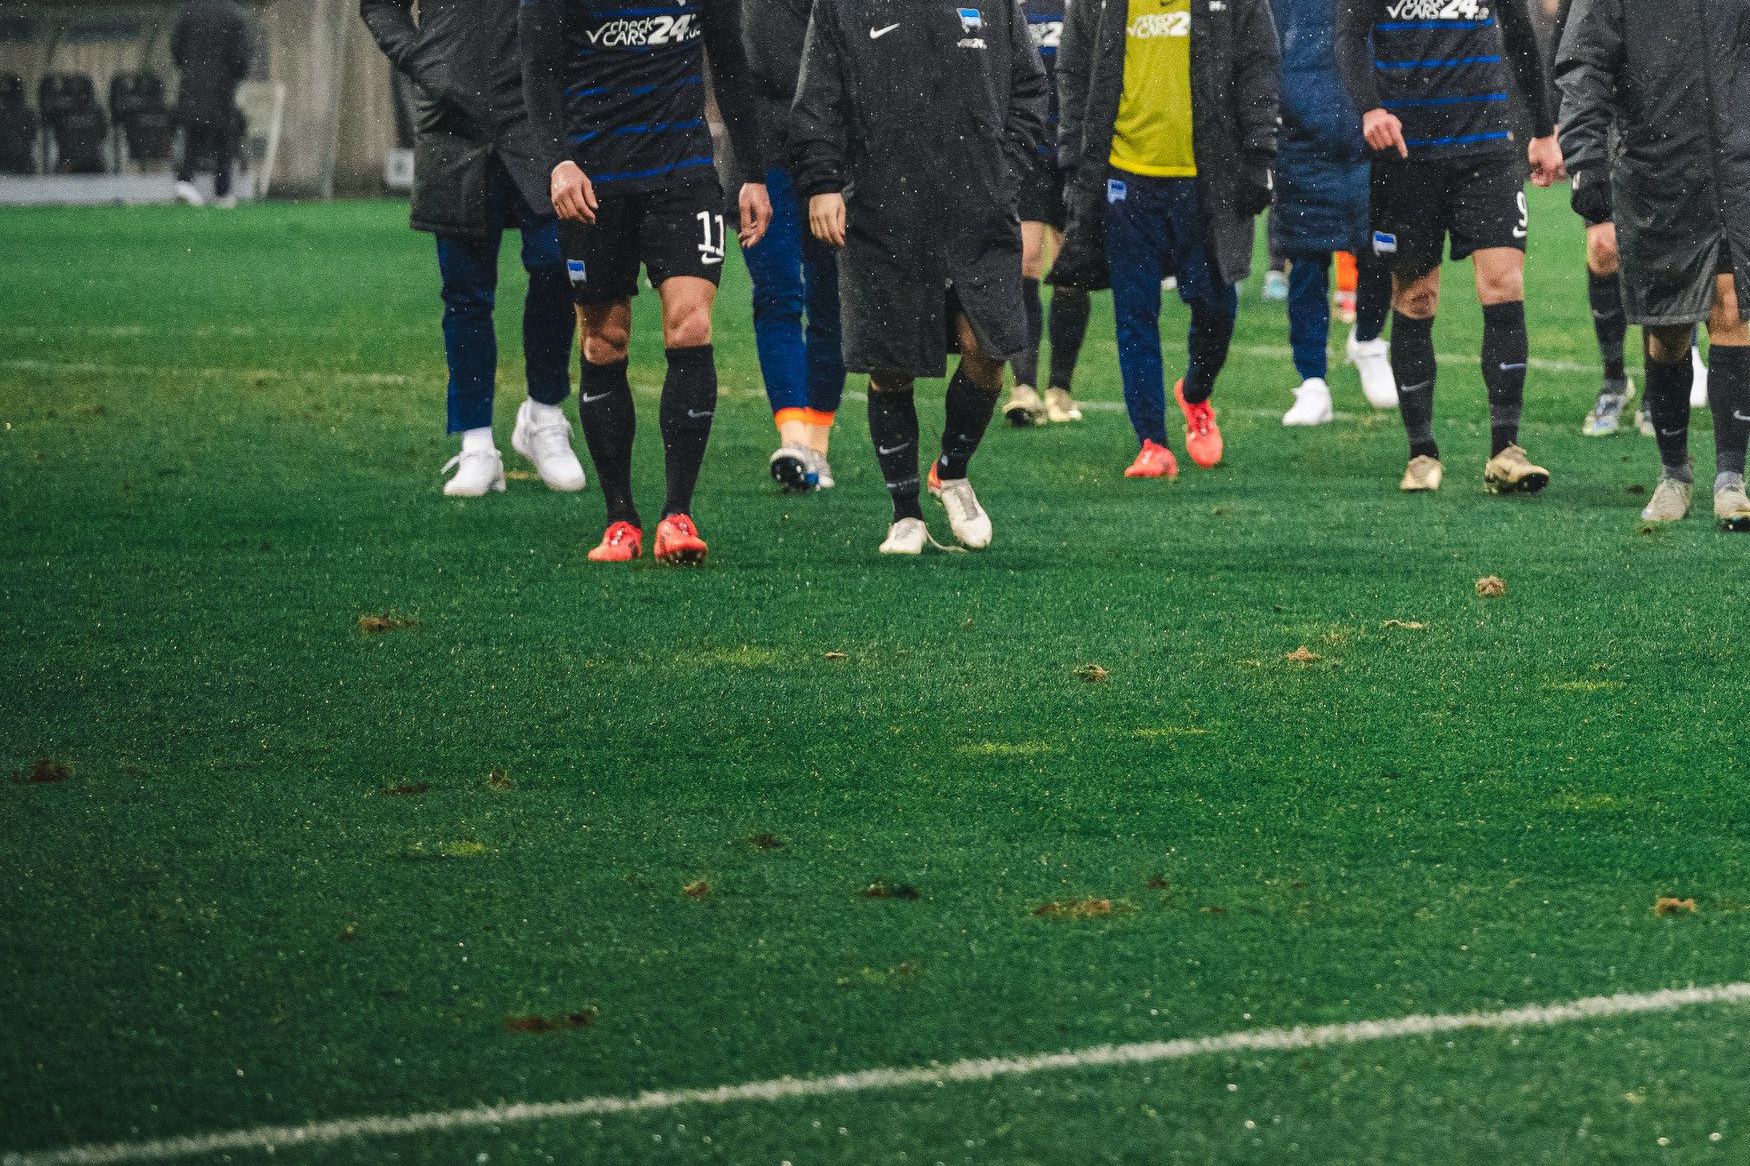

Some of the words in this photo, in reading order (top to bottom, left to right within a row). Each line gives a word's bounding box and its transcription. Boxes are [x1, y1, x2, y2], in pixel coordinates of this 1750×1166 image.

[610, 17, 656, 34] check
[602, 29, 648, 47] CARS
[696, 210, 725, 257] 11
